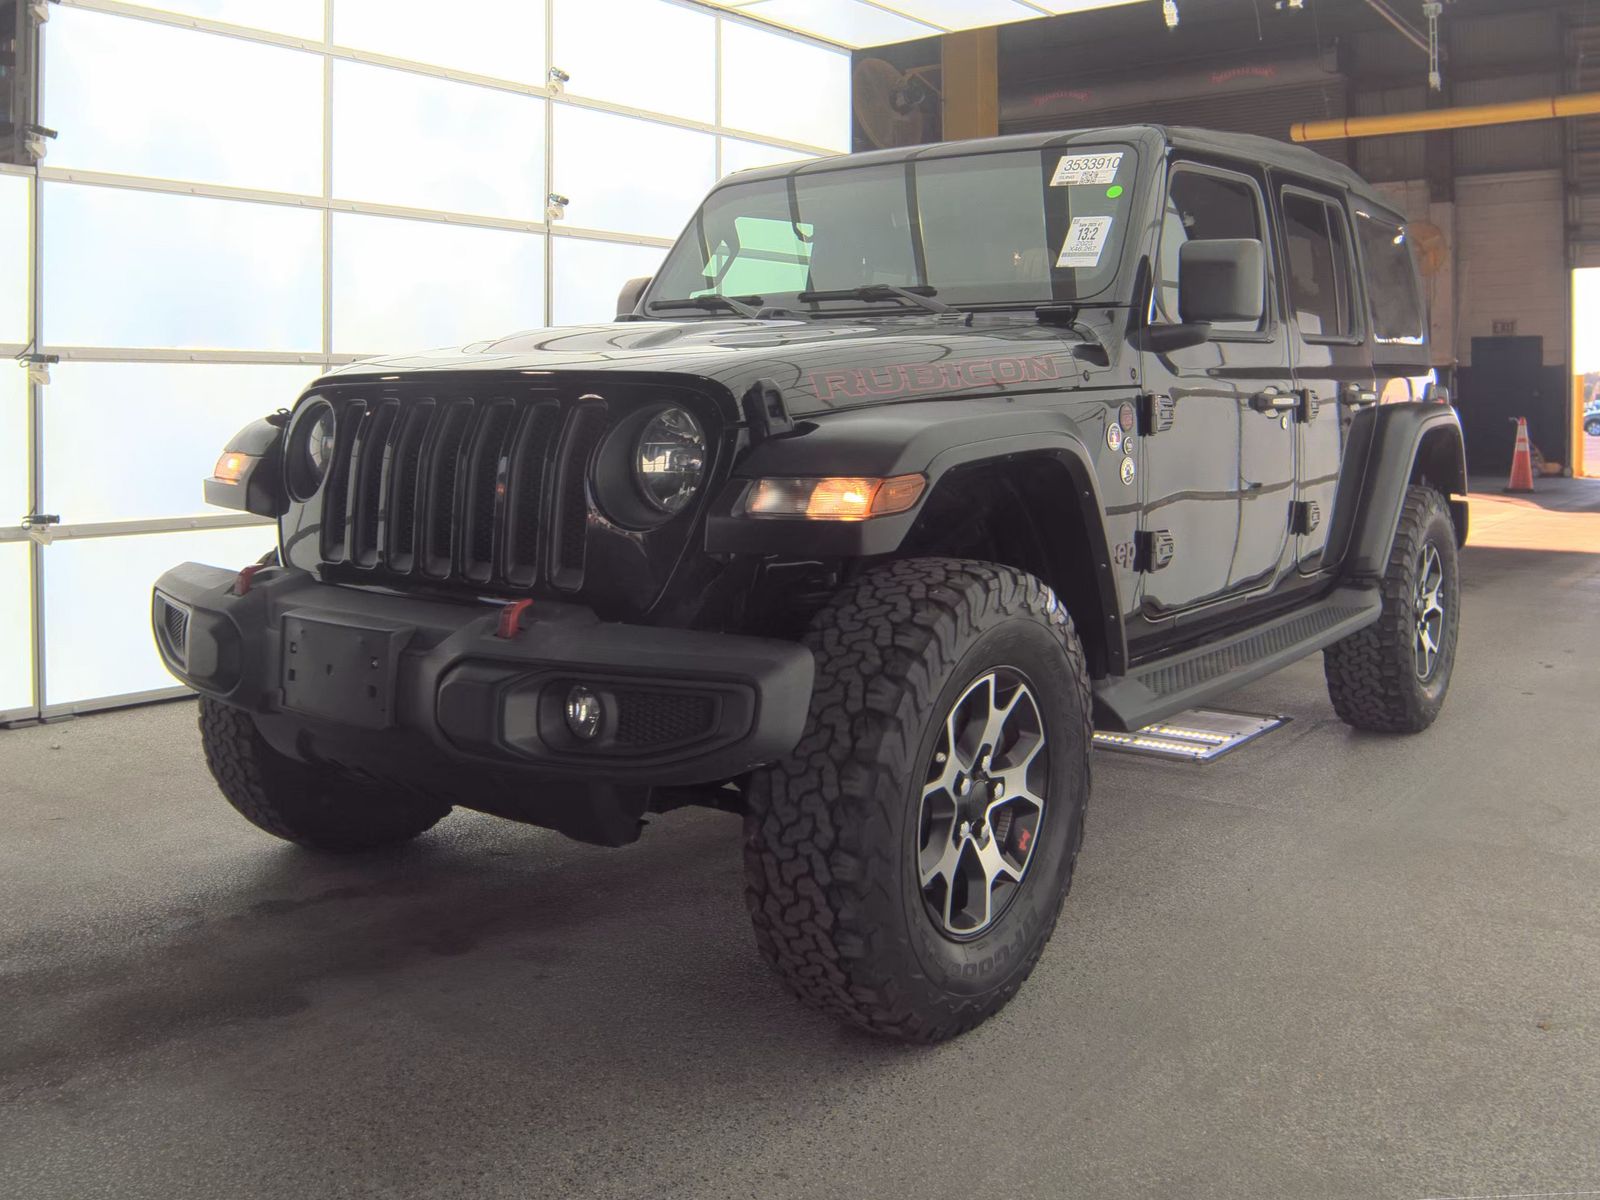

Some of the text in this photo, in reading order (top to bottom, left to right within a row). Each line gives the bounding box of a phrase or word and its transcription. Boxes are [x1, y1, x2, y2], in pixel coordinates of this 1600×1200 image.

[1064, 157, 1121, 172] 3533910
[1077, 227, 1099, 241] 13:2
[808, 356, 1061, 400] RUBICON
